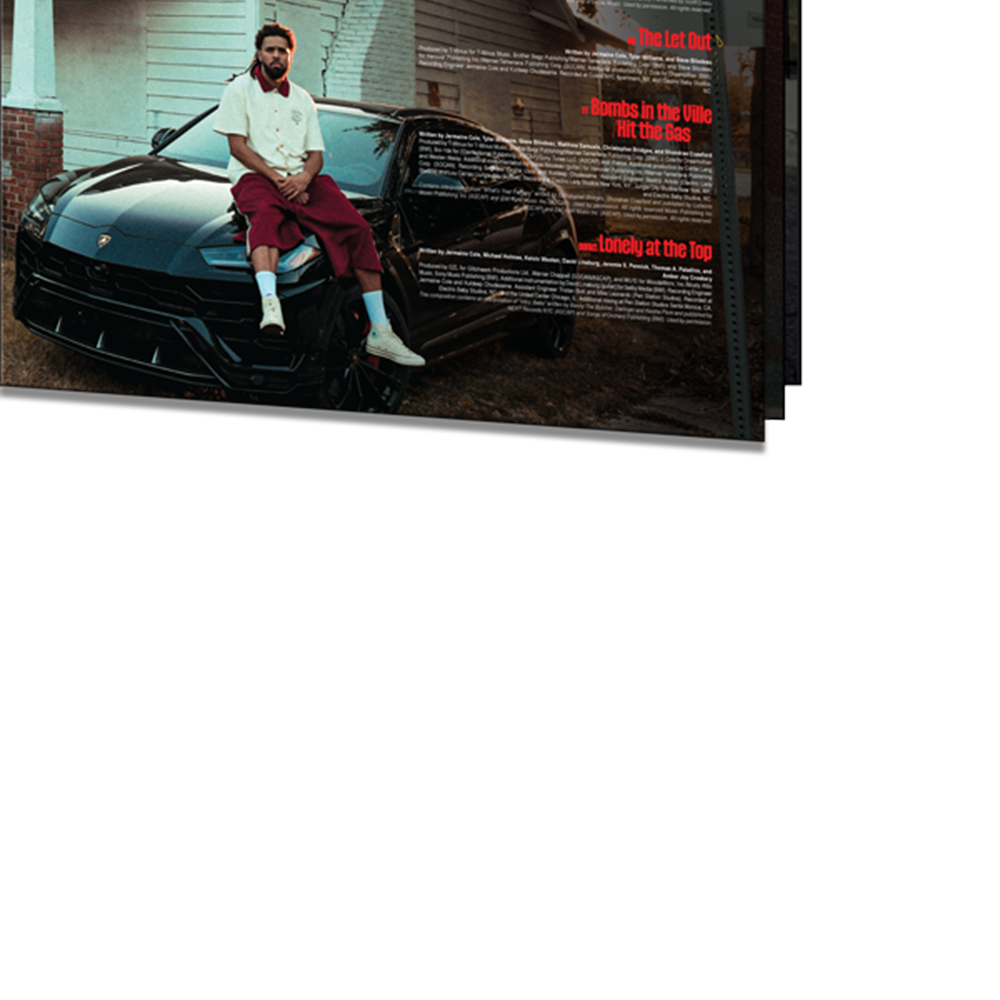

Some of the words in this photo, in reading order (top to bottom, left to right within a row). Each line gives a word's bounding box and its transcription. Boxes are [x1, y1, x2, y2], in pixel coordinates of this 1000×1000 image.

[638, 28, 662, 48] The
[664, 30, 686, 50] Let
[688, 32, 712, 52] Out
[590, 96, 640, 120] Bombs
[640, 100, 654, 120] in
[656, 102, 680, 122] the
[682, 104, 712, 124] Ville
[616, 118, 638, 138] Hit
[638, 120, 662, 140] the
[664, 122, 692, 142] Gas
[598, 234, 644, 258] Lonely
[646, 238, 660, 256] at
[662, 238, 688, 258] the
[688, 240, 712, 262] Top
